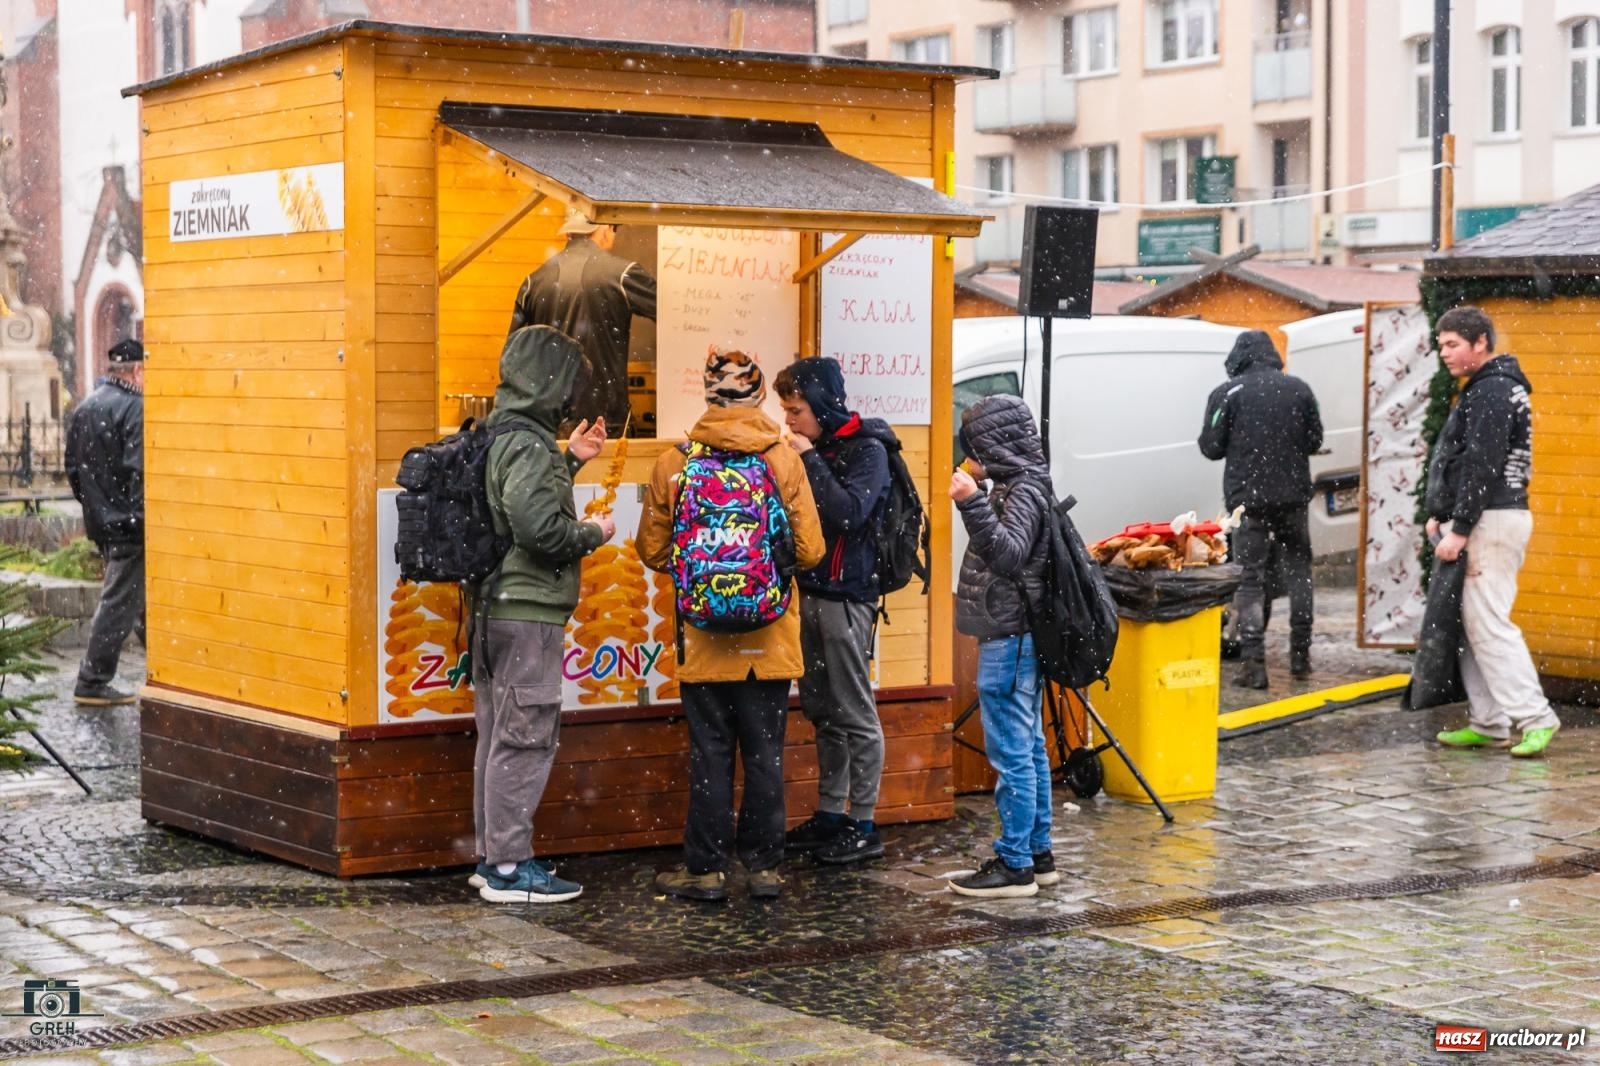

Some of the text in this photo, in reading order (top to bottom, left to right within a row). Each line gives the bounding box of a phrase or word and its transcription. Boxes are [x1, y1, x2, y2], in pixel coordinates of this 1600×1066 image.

[173, 204, 250, 236] ZIEMNIAK
[661, 246, 793, 283] ZIEMNIAK
[838, 298, 916, 323] KAWA
[833, 352, 926, 376] HERBATA
